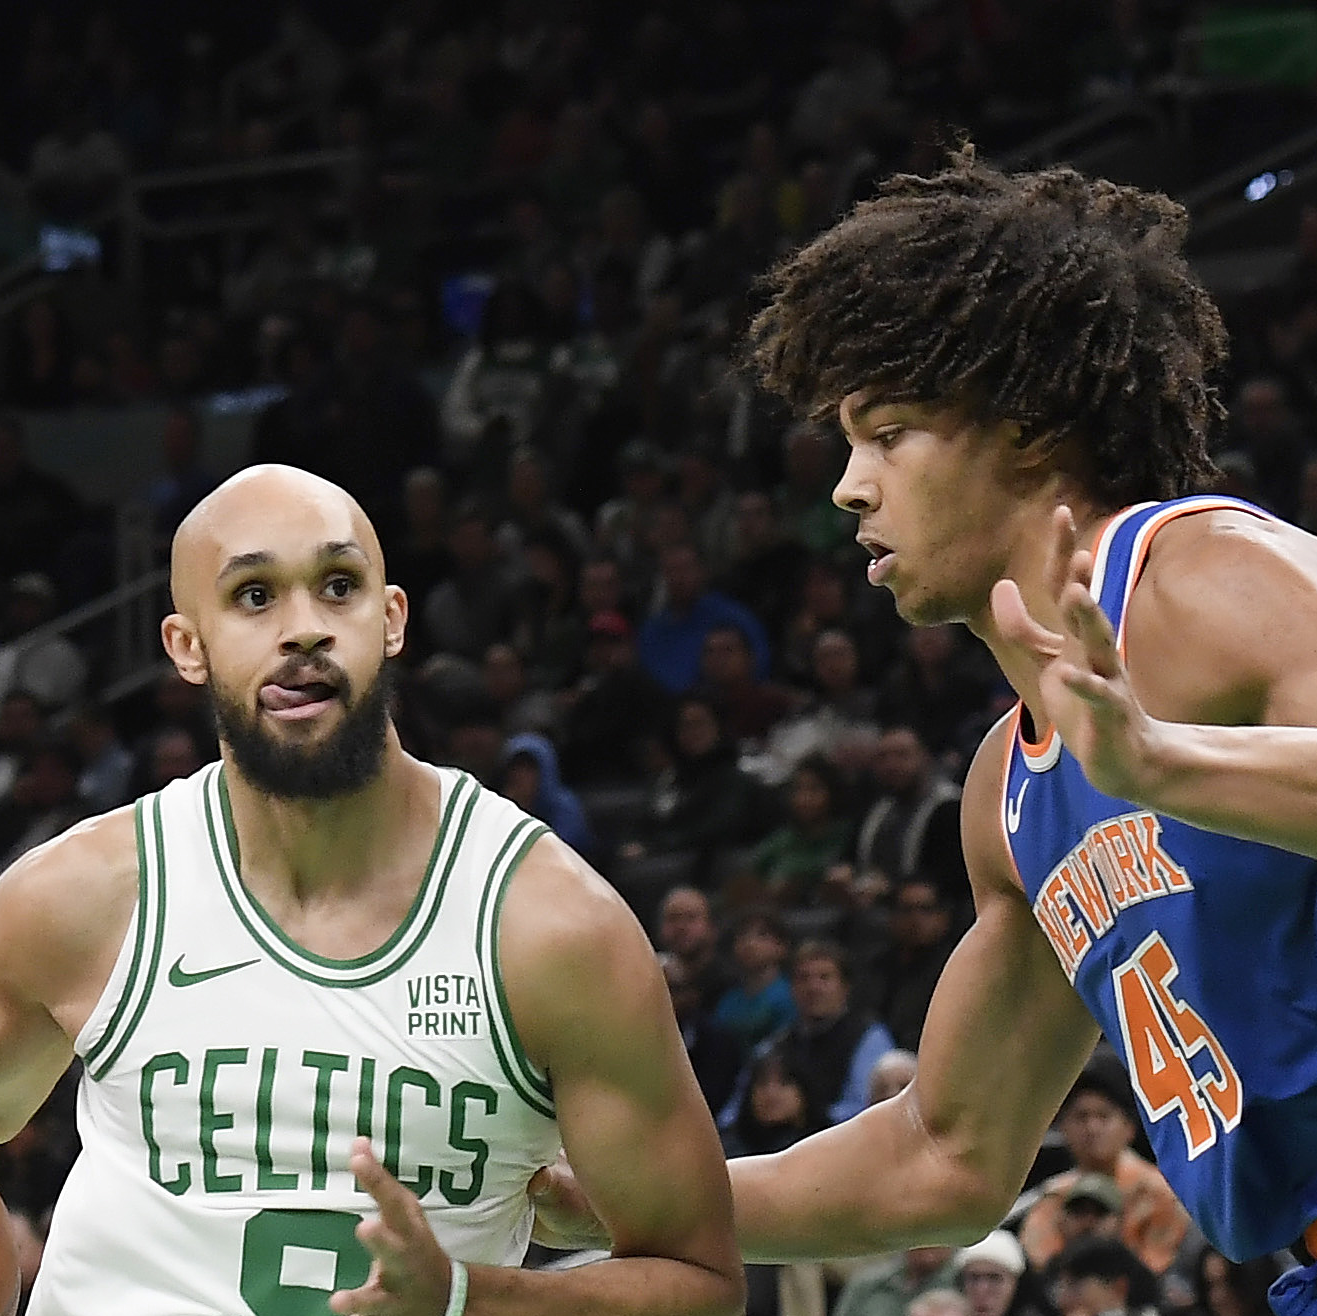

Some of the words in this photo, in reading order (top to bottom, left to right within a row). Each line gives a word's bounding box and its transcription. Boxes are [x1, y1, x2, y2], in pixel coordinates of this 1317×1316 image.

[1033, 851, 1115, 987] NEW
[1087, 810, 1195, 917] ORK
[407, 974, 481, 1009] VISTA
[408, 1011, 481, 1036] PRINT
[1112, 930, 1243, 1161] 45
[140, 1047, 498, 1205] CELTICS
